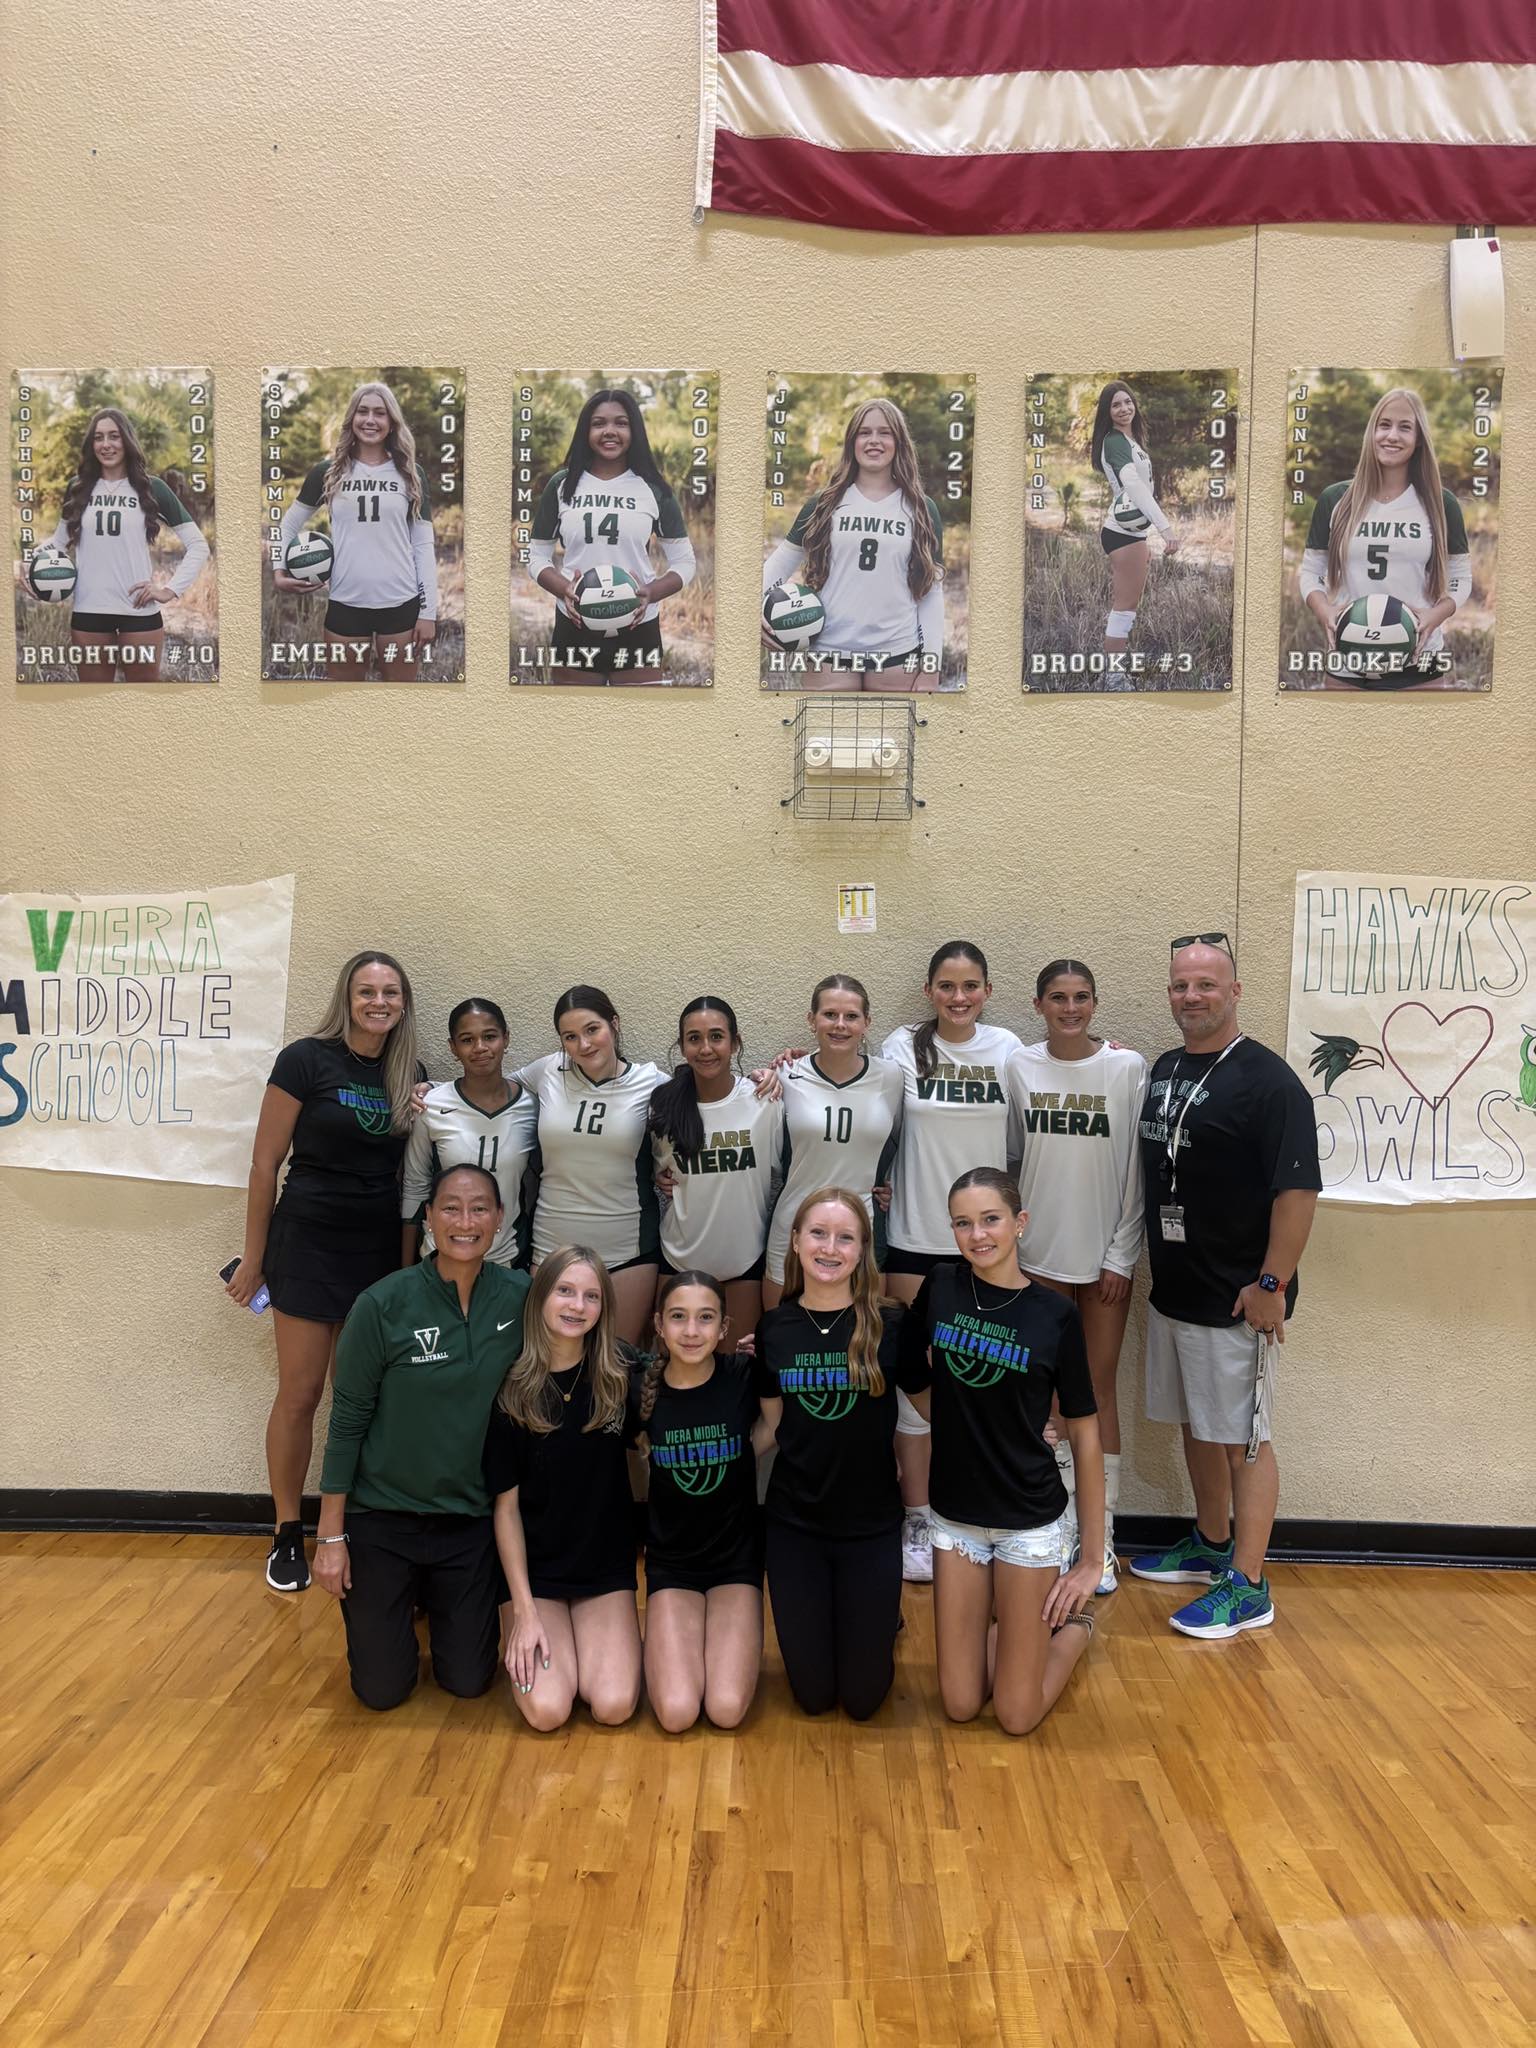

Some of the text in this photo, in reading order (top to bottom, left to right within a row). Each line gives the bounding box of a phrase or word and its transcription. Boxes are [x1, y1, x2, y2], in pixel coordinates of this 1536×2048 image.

[189, 385, 207, 493] 2025
[440, 385, 456, 493] 2025
[692, 388, 709, 495] 2025
[772, 390, 788, 506] JUNIOR
[947, 392, 965, 499] 2025
[1031, 392, 1045, 508] JUNIOR
[1209, 389, 1227, 498] 2025
[1293, 385, 1308, 504] JUNIOR
[1472, 387, 1491, 496] 2025
[18, 387, 34, 562] SOPHOMORE
[267, 384, 283, 561] SOPHOMORE
[342, 480, 398, 492] HAWKS
[517, 387, 533, 563] SOPHOMORE
[357, 495, 380, 522] 11
[572, 494, 636, 510] HAWKS
[95, 510, 121, 536] 10
[582, 512, 619, 545] 14
[839, 516, 906, 537] HAWKS
[858, 538, 879, 571] 8
[1367, 544, 1389, 580] 5
[1364, 629, 1381, 641] L2
[22, 645, 214, 664] BRIGHTON #10
[271, 642, 434, 663] EMERY #11
[518, 647, 661, 668] LILLY #14
[768, 651, 939, 673] HAYLEY #8
[1031, 652, 1193, 673] BROOKE #3
[1288, 651, 1452, 672] BROOKE #5
[25, 901, 222, 975] VIERA
[1303, 885, 1532, 998] HAWKS
[958, 1064, 997, 1081] ARE
[915, 1077, 1006, 1104] VIERA
[1030, 1092, 1107, 1112] WE ARE
[572, 1100, 607, 1135] 12
[823, 1105, 853, 1143] 10
[1024, 1109, 1110, 1138] VIERA
[478, 1135, 499, 1172] 11
[710, 1129, 752, 1149] ARE
[1311, 1089, 1525, 1188] OWLS
[672, 1147, 757, 1175] VIERA
[414, 1326, 440, 1355] V
[953, 1312, 1018, 1342] VIERA MIDDLE
[411, 1351, 449, 1363] VOLLEYBALL
[795, 1351, 848, 1367] VIERA MIDD
[933, 1320, 1030, 1374] VOLLEYBALL
[665, 1423, 728, 1445] VIERA MIDDLE
[651, 1434, 742, 1469] VOLLEYBALL
